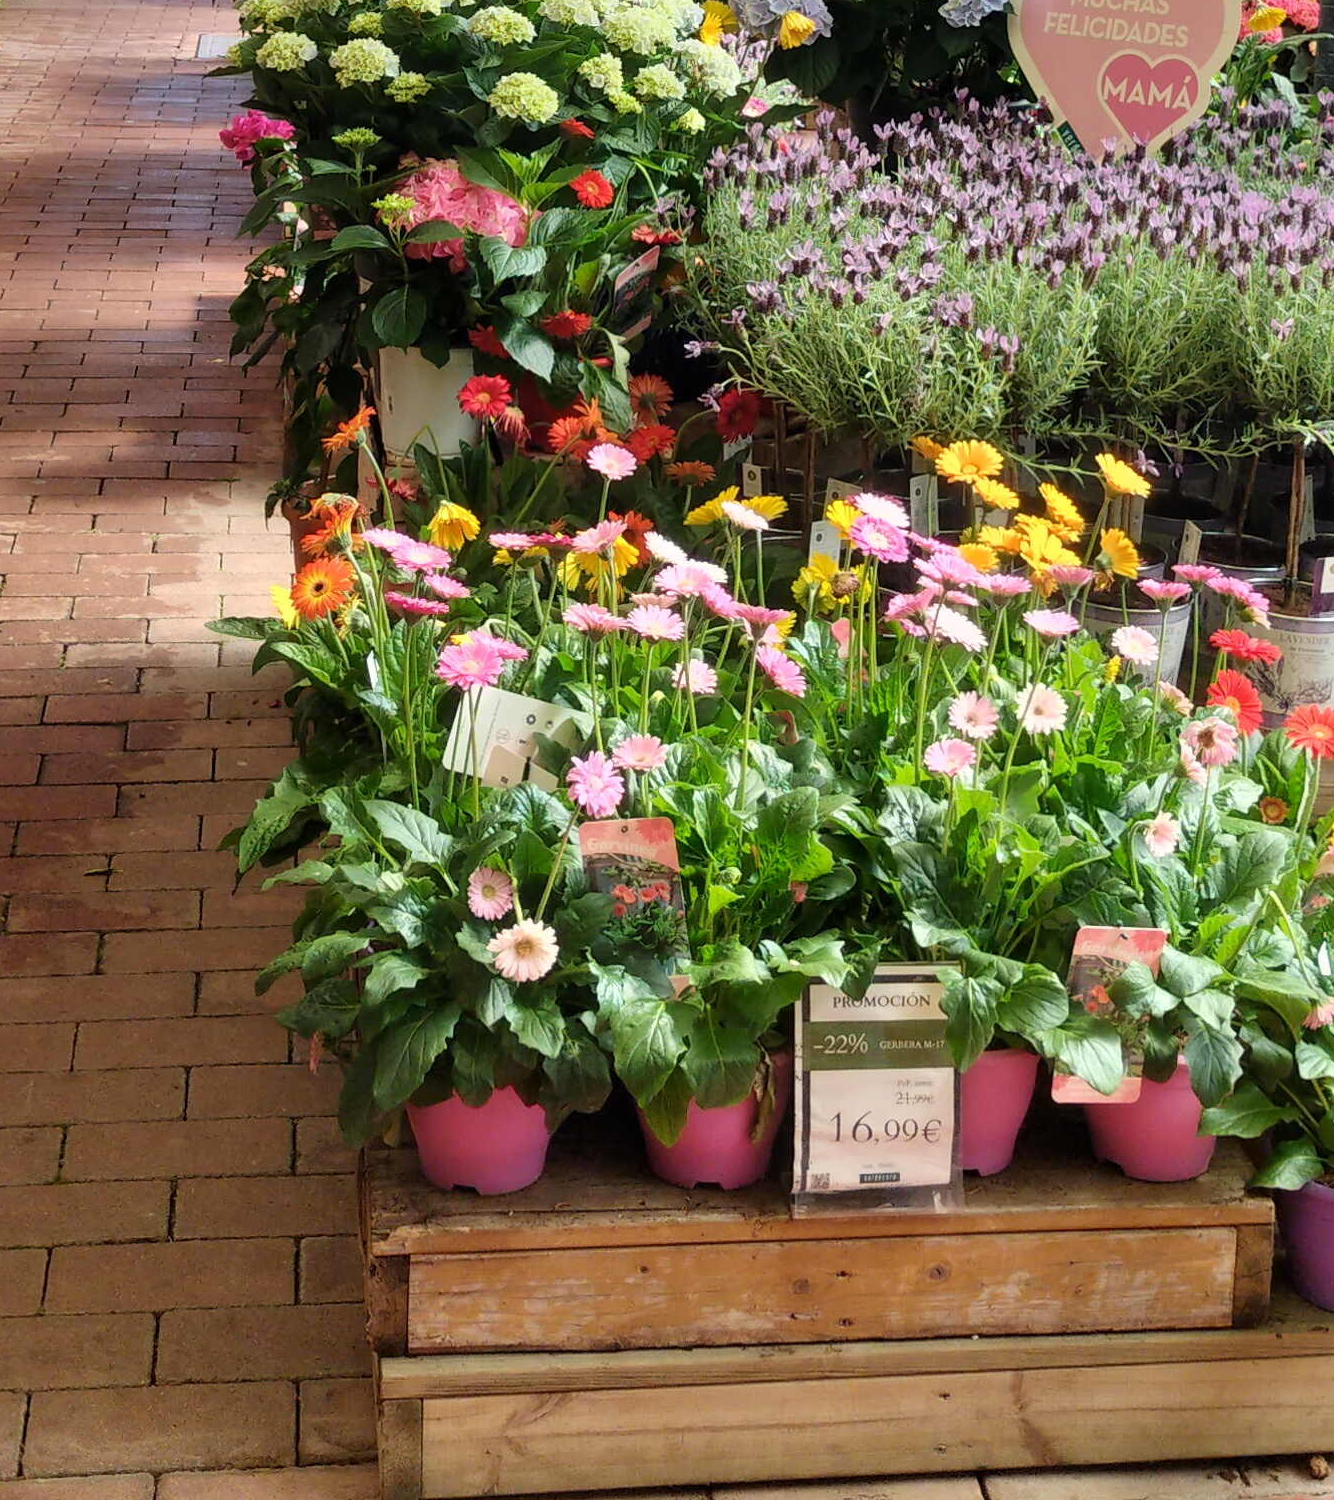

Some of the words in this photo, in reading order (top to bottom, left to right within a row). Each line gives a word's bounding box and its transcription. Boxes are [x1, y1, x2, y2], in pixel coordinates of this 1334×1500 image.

[1043, 12, 1189, 49] FELICIDADES
[1102, 75, 1193, 111] MAMÁ
[1279, 633, 1331, 645] LAVENDER
[586, 837, 658, 858] Garvinea
[813, 1032, 869, 1055] -22%
[879, 1040, 922, 1050] GERBERA
[923, 1039, 946, 1049] M-17
[830, 1110, 943, 1145] 16,99€
